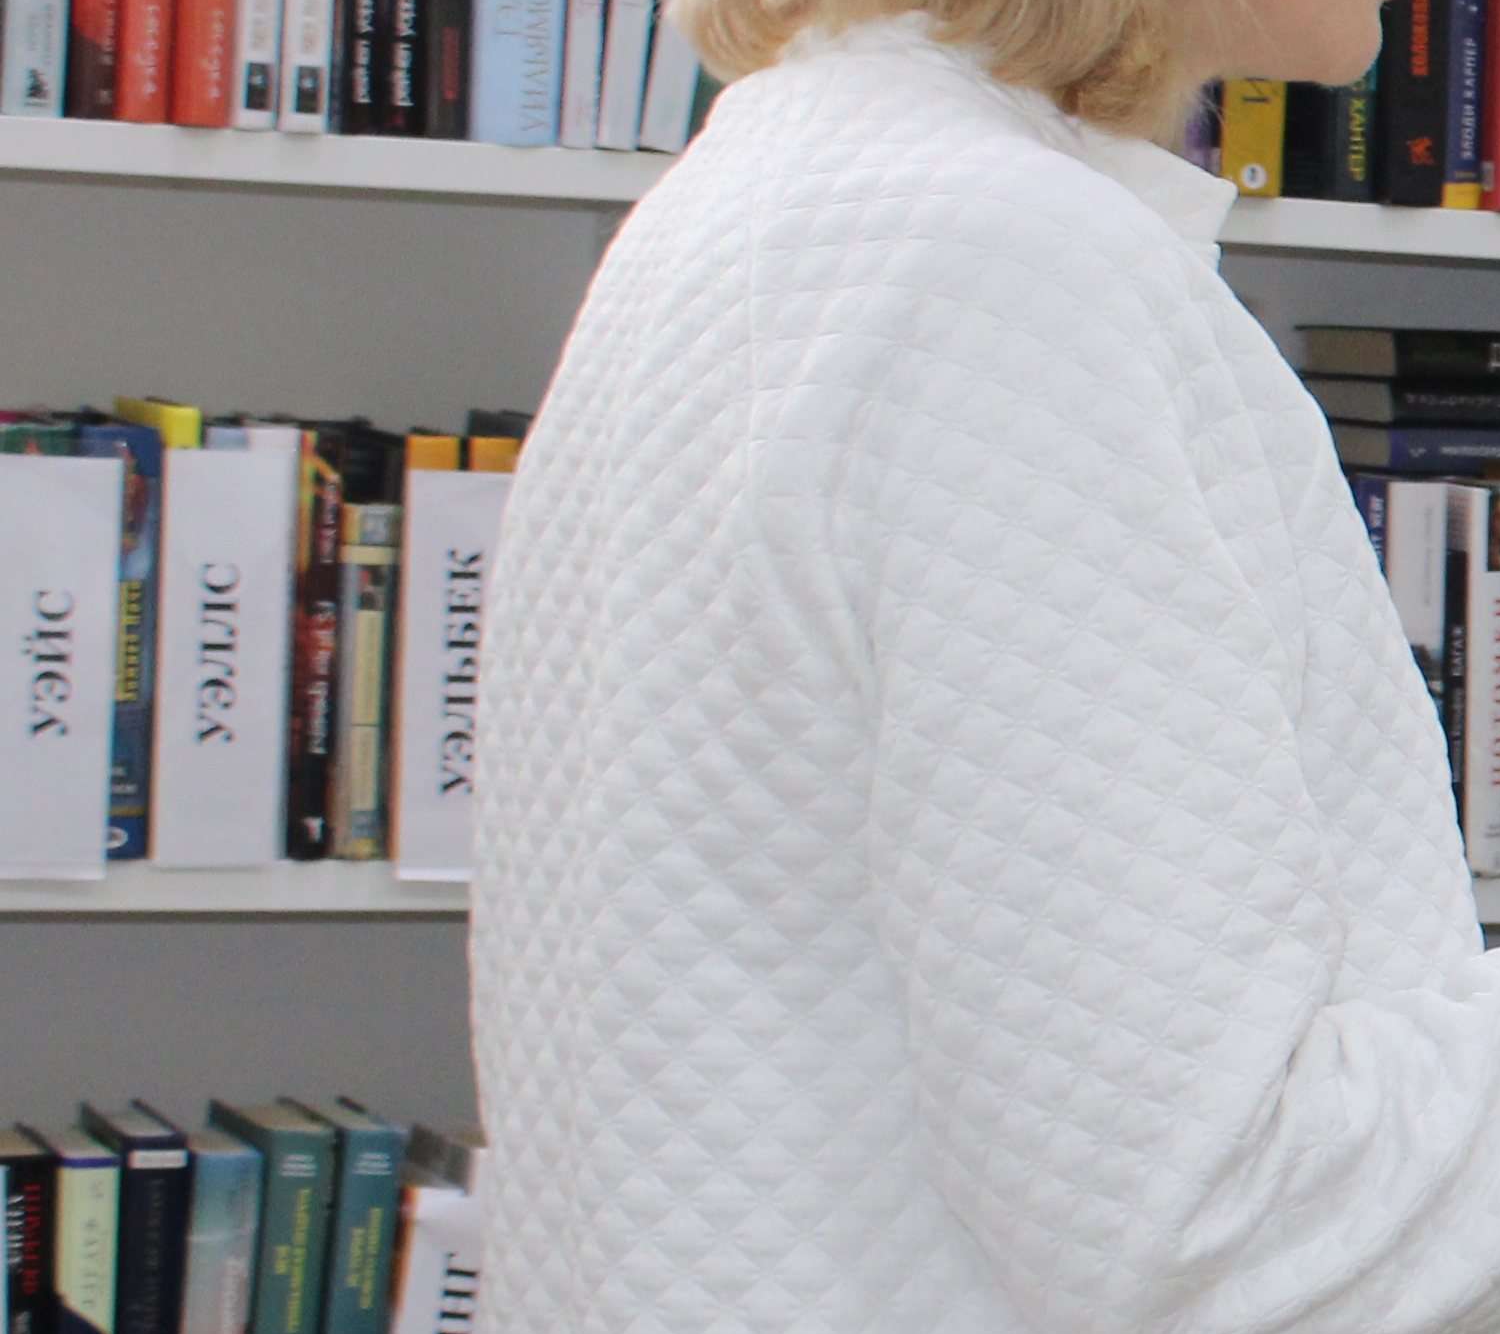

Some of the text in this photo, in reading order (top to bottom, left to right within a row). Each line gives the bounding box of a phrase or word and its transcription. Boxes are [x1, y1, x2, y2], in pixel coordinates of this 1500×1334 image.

[1348, 98, 1368, 181] ХАНТЕР
[1461, 36, 1478, 162] ЭЛОДИ ХАРПЕР
[23, 589, 75, 737] УЭЙС
[196, 563, 241, 743] УЭЛЛС
[439, 549, 483, 795] УЭЛЬБЕК
